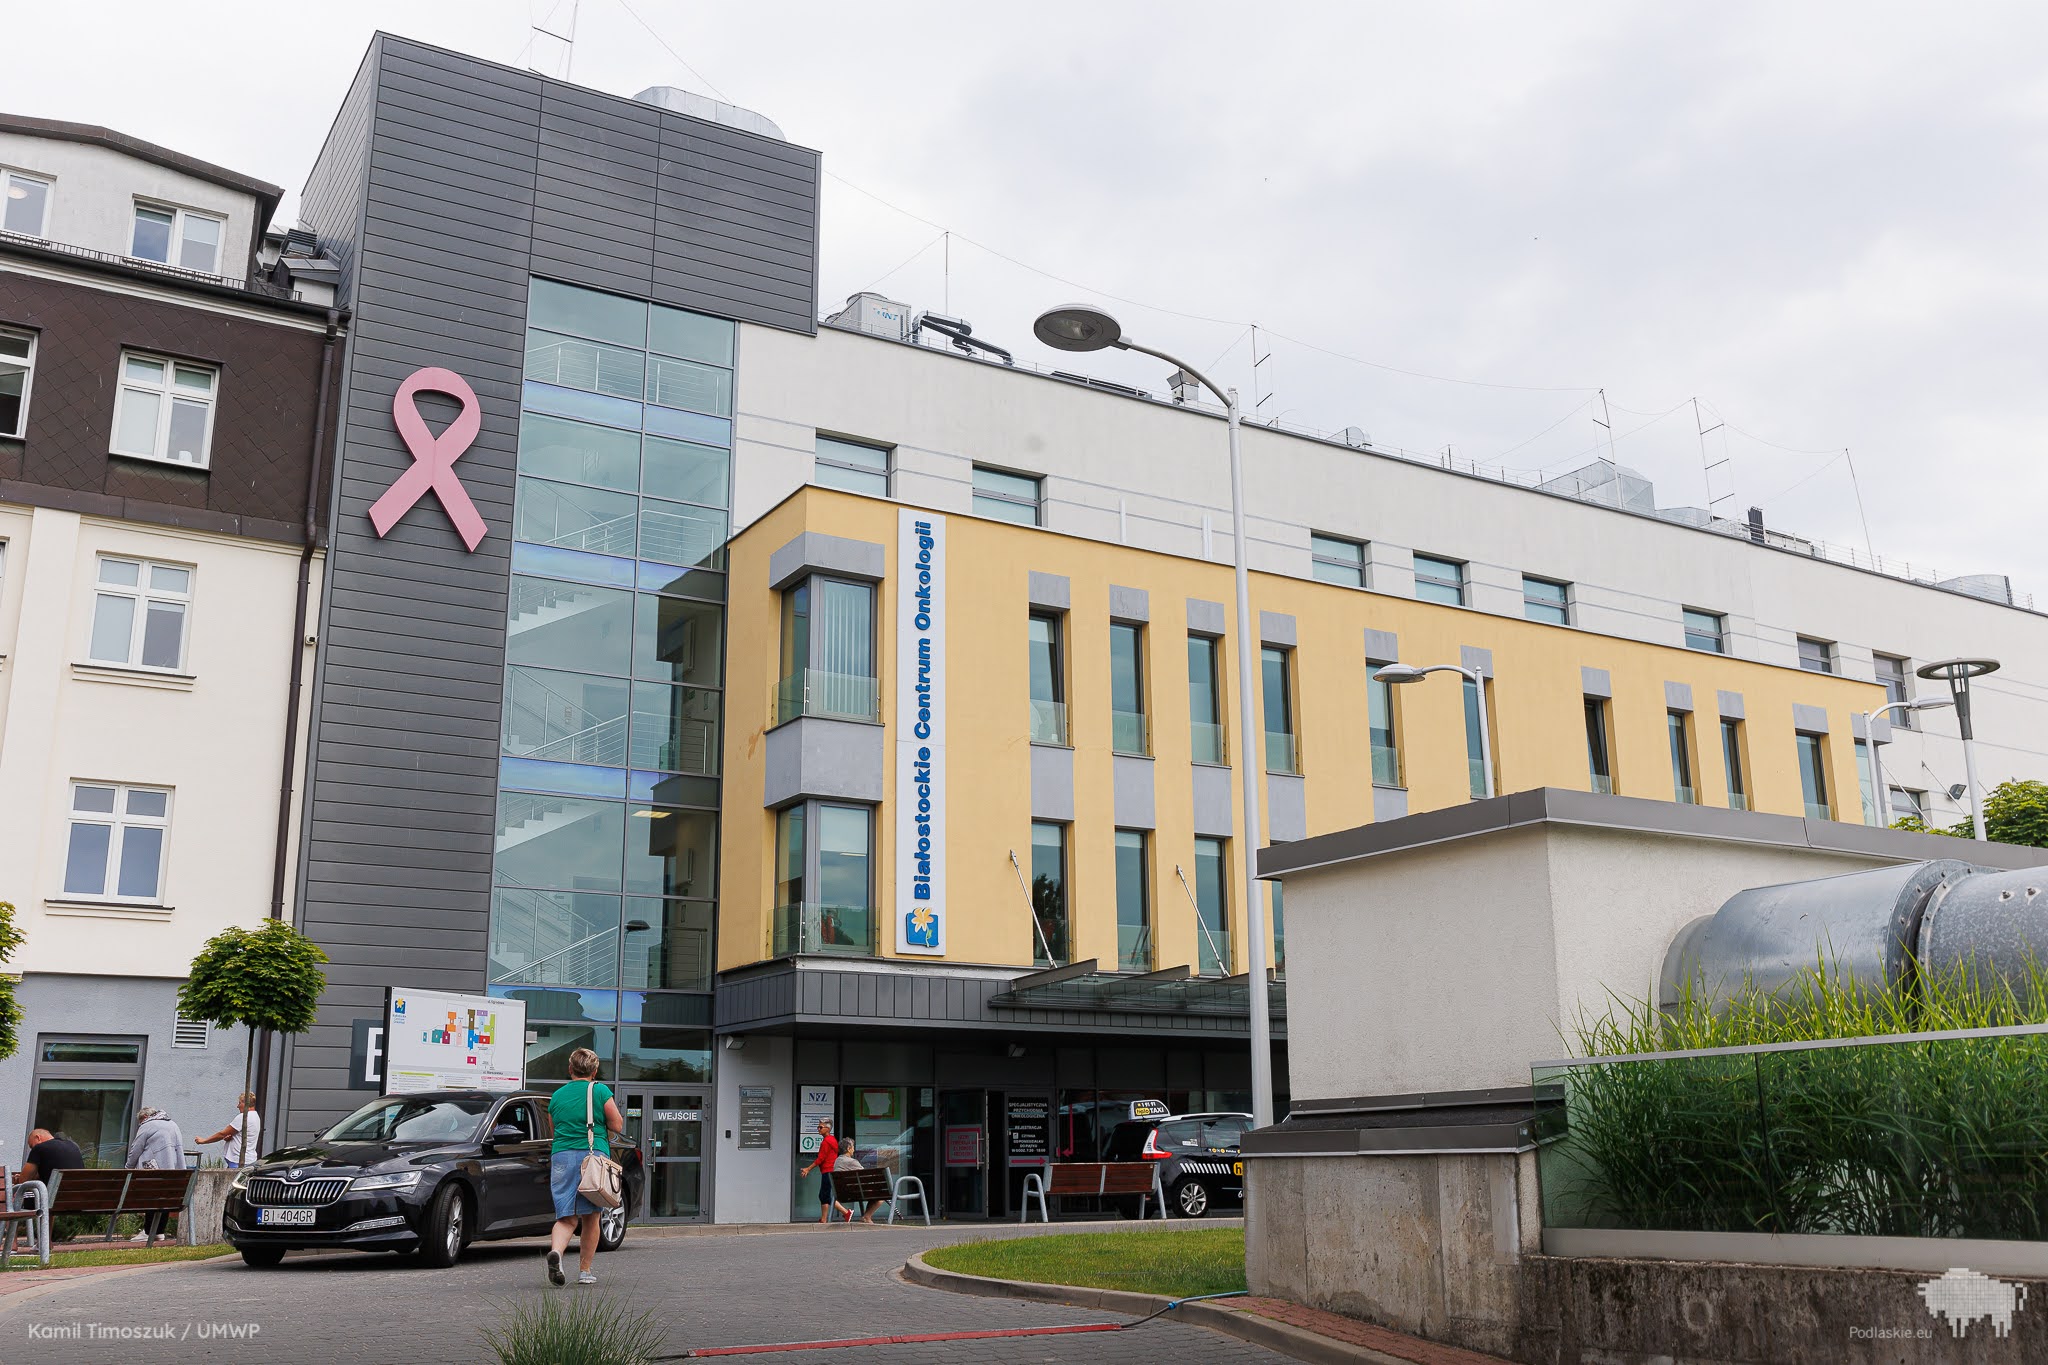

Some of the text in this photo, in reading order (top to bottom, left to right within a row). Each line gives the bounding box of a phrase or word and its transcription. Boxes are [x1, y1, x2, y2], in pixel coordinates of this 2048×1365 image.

[912, 519, 935, 900] Białostockie Centrum Onkologii
[809, 1092, 827, 1102] NFZ
[658, 1111, 697, 1121] WEJŚCIE
[280, 1210, 313, 1222] 404GR
